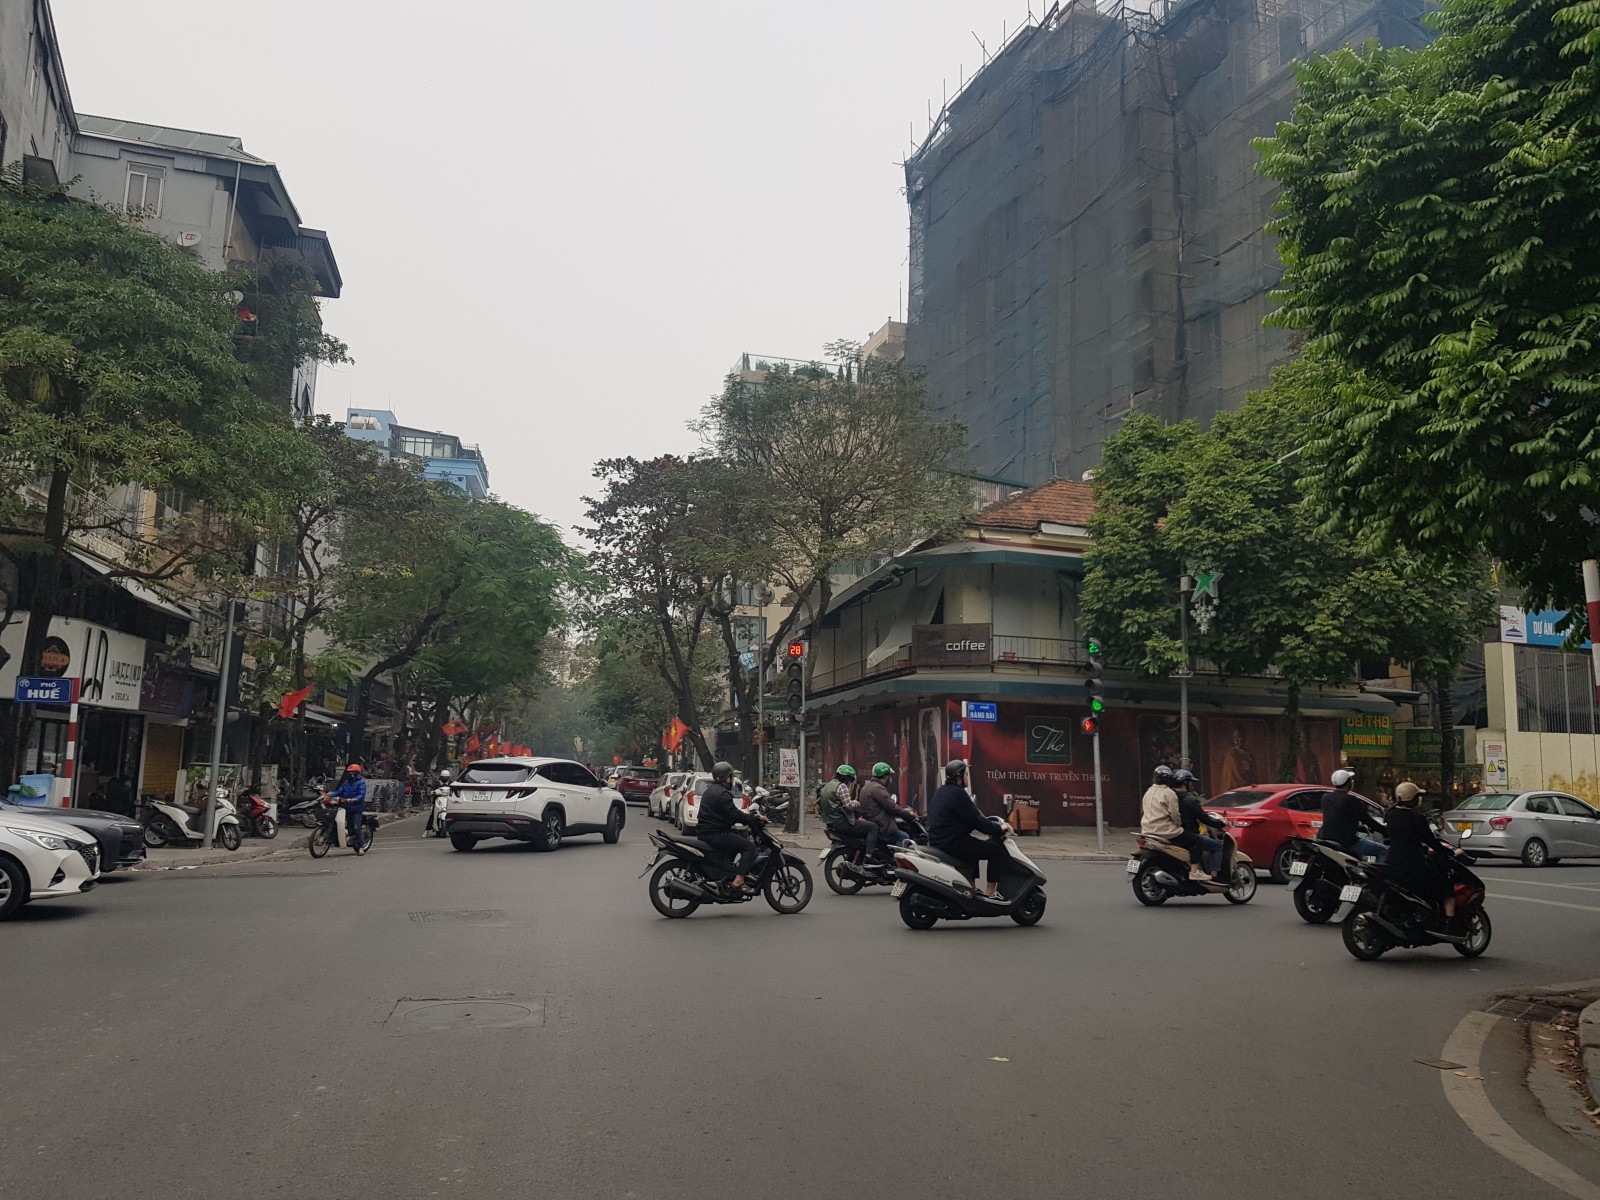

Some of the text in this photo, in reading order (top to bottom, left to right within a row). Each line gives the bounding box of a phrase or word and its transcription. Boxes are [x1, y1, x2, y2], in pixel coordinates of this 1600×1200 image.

[790, 645, 801, 655] 28
[945, 640, 986, 651] coffee
[27, 688, 61, 699] HUẾ
[970, 711, 995, 719] HÀNG BÀI
[1354, 734, 1376, 745] PHONG
[986, 769, 1006, 781] TIỆM
[1008, 770, 1030, 779] THÊU
[1032, 772, 1047, 780] TAY
[1049, 770, 1080, 781] TRUYỀN
